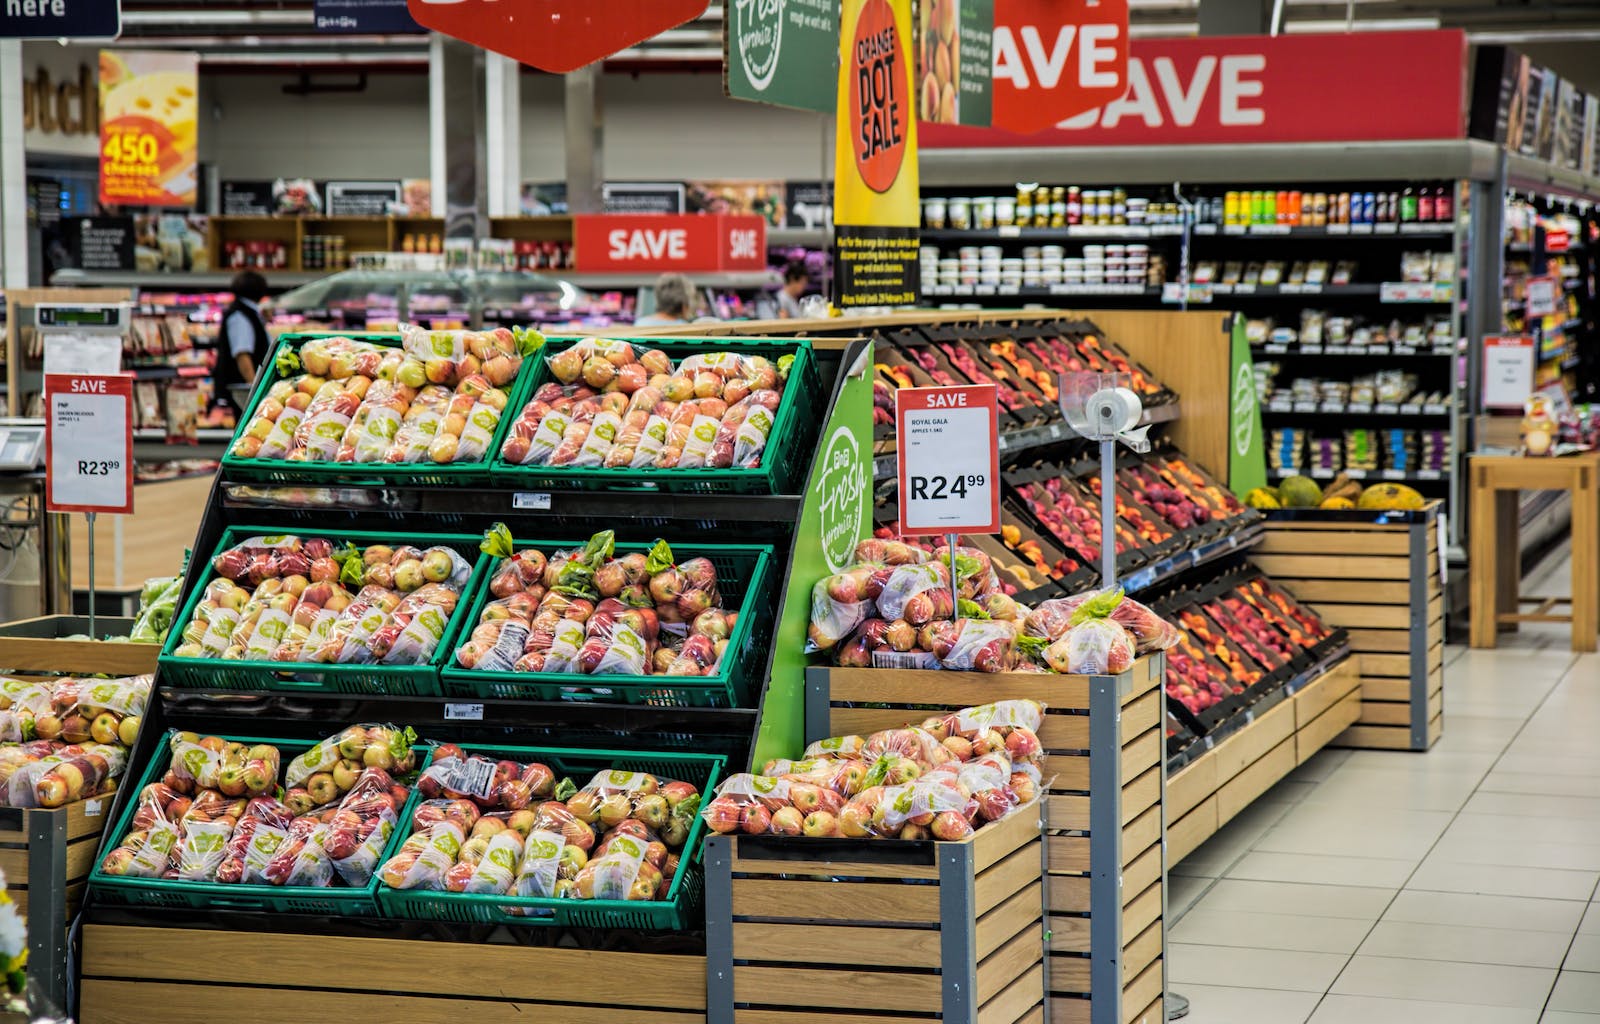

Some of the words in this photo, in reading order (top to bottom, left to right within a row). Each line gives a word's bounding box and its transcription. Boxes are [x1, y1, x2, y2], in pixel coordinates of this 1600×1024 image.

[7, 0, 65, 16] here
[857, 26, 894, 65] ORANGE
[992, 24, 1100, 89] AVE
[858, 53, 895, 117] DOT
[861, 102, 902, 161] SALE
[103, 133, 158, 163] 450
[608, 228, 688, 260] SAVE
[730, 228, 758, 259] SAVE
[71, 379, 106, 393] SAVE
[926, 392, 967, 407] SAVE
[816, 441, 867, 523] Fresh
